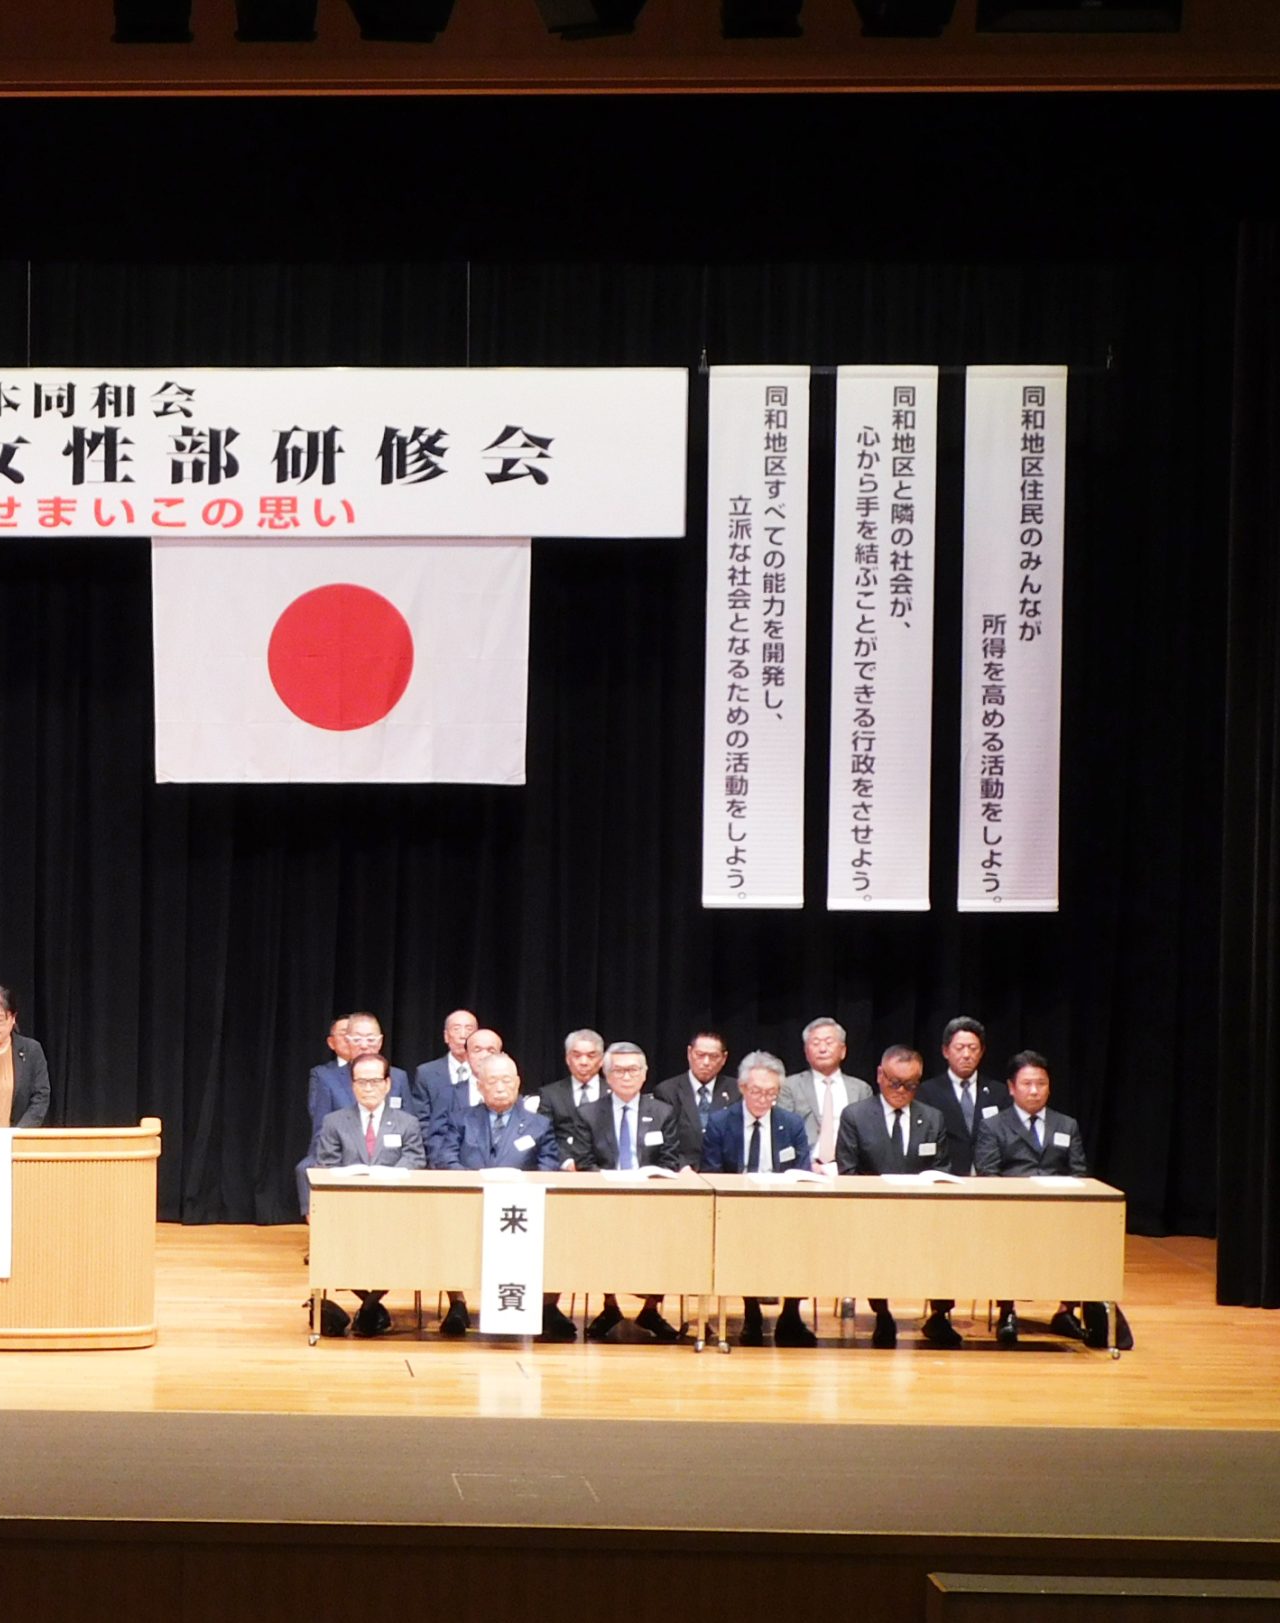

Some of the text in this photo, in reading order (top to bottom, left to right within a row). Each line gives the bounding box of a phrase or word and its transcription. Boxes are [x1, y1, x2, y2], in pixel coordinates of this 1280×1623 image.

[762, 386, 787, 719] 同和地区すべての能力を開発し、
[890, 386, 915, 628] 同和地区と隣の社会が、
[1019, 386, 1045, 642] 同和地区住民のみんなが
[726, 496, 752, 899] 立派な社会となるための活動をしよう。
[851, 426, 880, 902] 心から手を結ぶことができる行政をさせよう。
[980, 614, 1008, 903] 所得を高める活動をしよう。
[499, 1206, 527, 1311] 来賓
